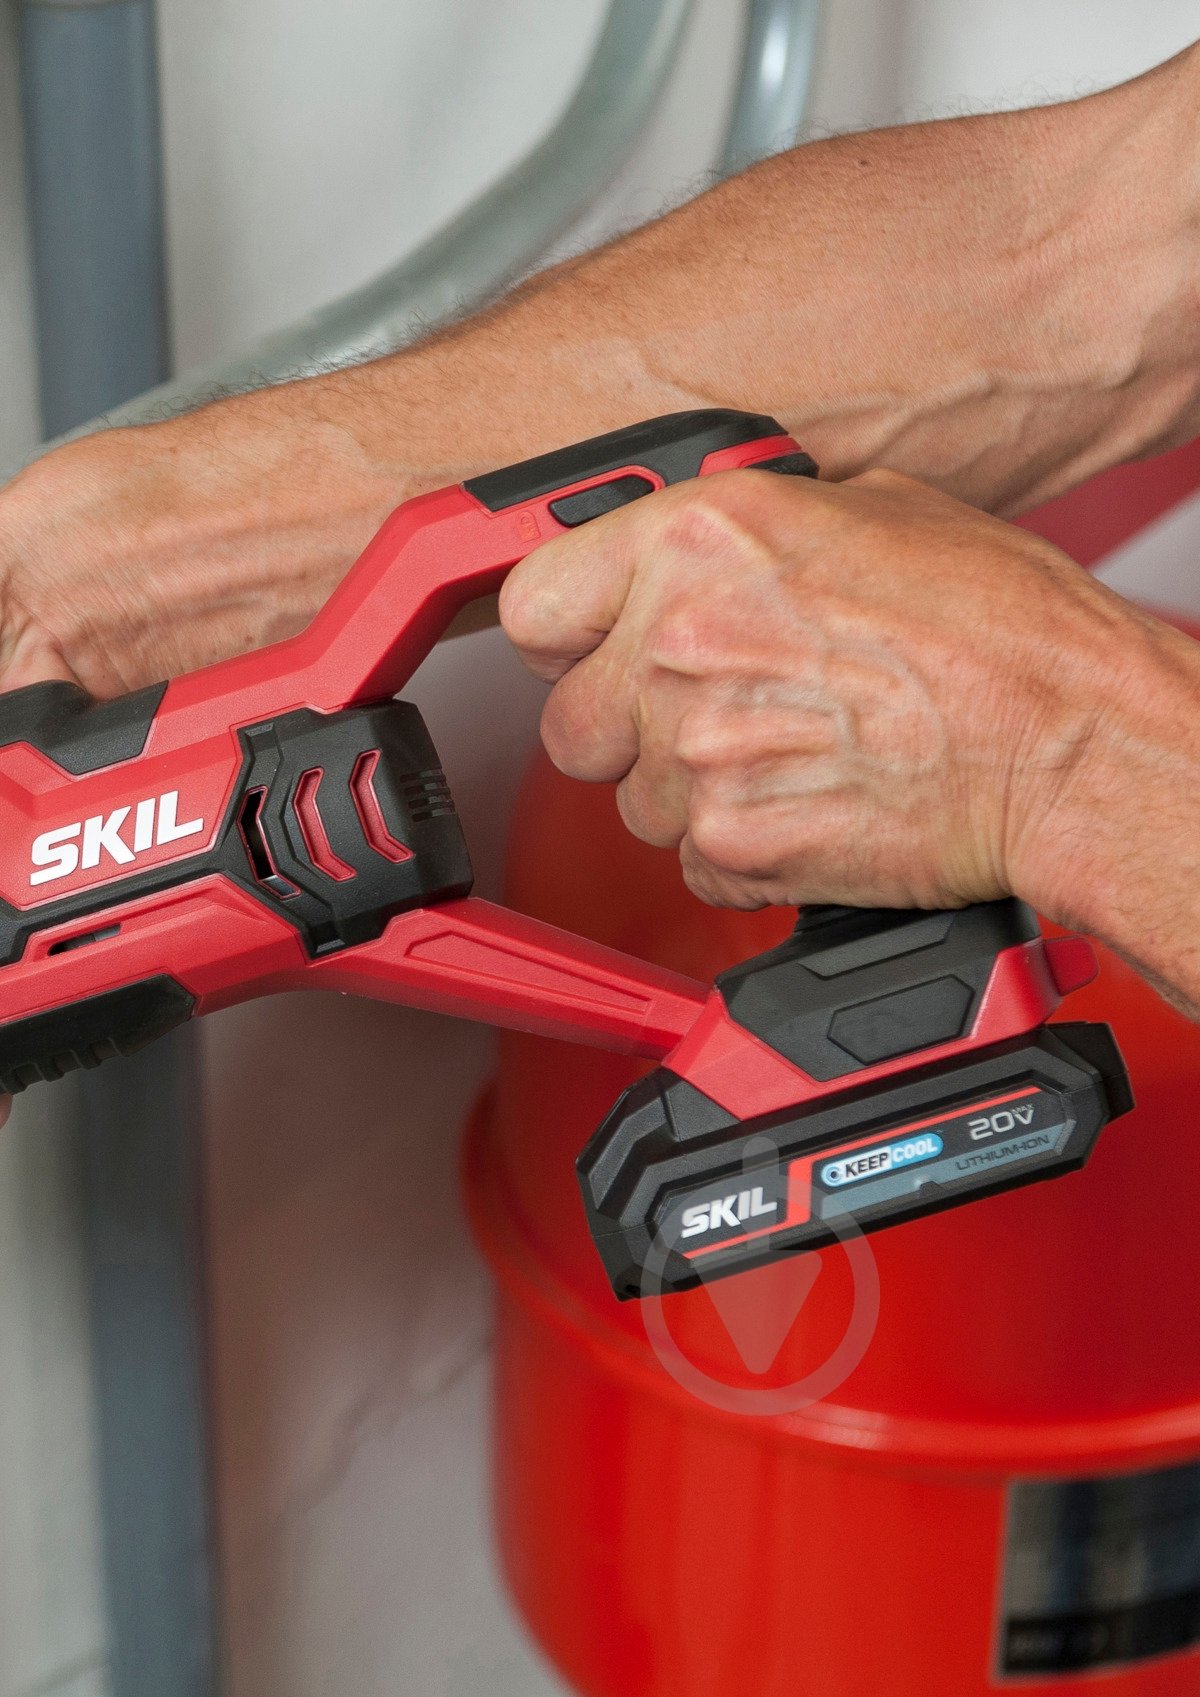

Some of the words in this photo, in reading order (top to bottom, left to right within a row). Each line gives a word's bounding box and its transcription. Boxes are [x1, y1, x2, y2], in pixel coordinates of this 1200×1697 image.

[30, 790, 203, 886] SKIL
[967, 1109, 1035, 1140] 20V
[681, 1187, 777, 1238] SKIL
